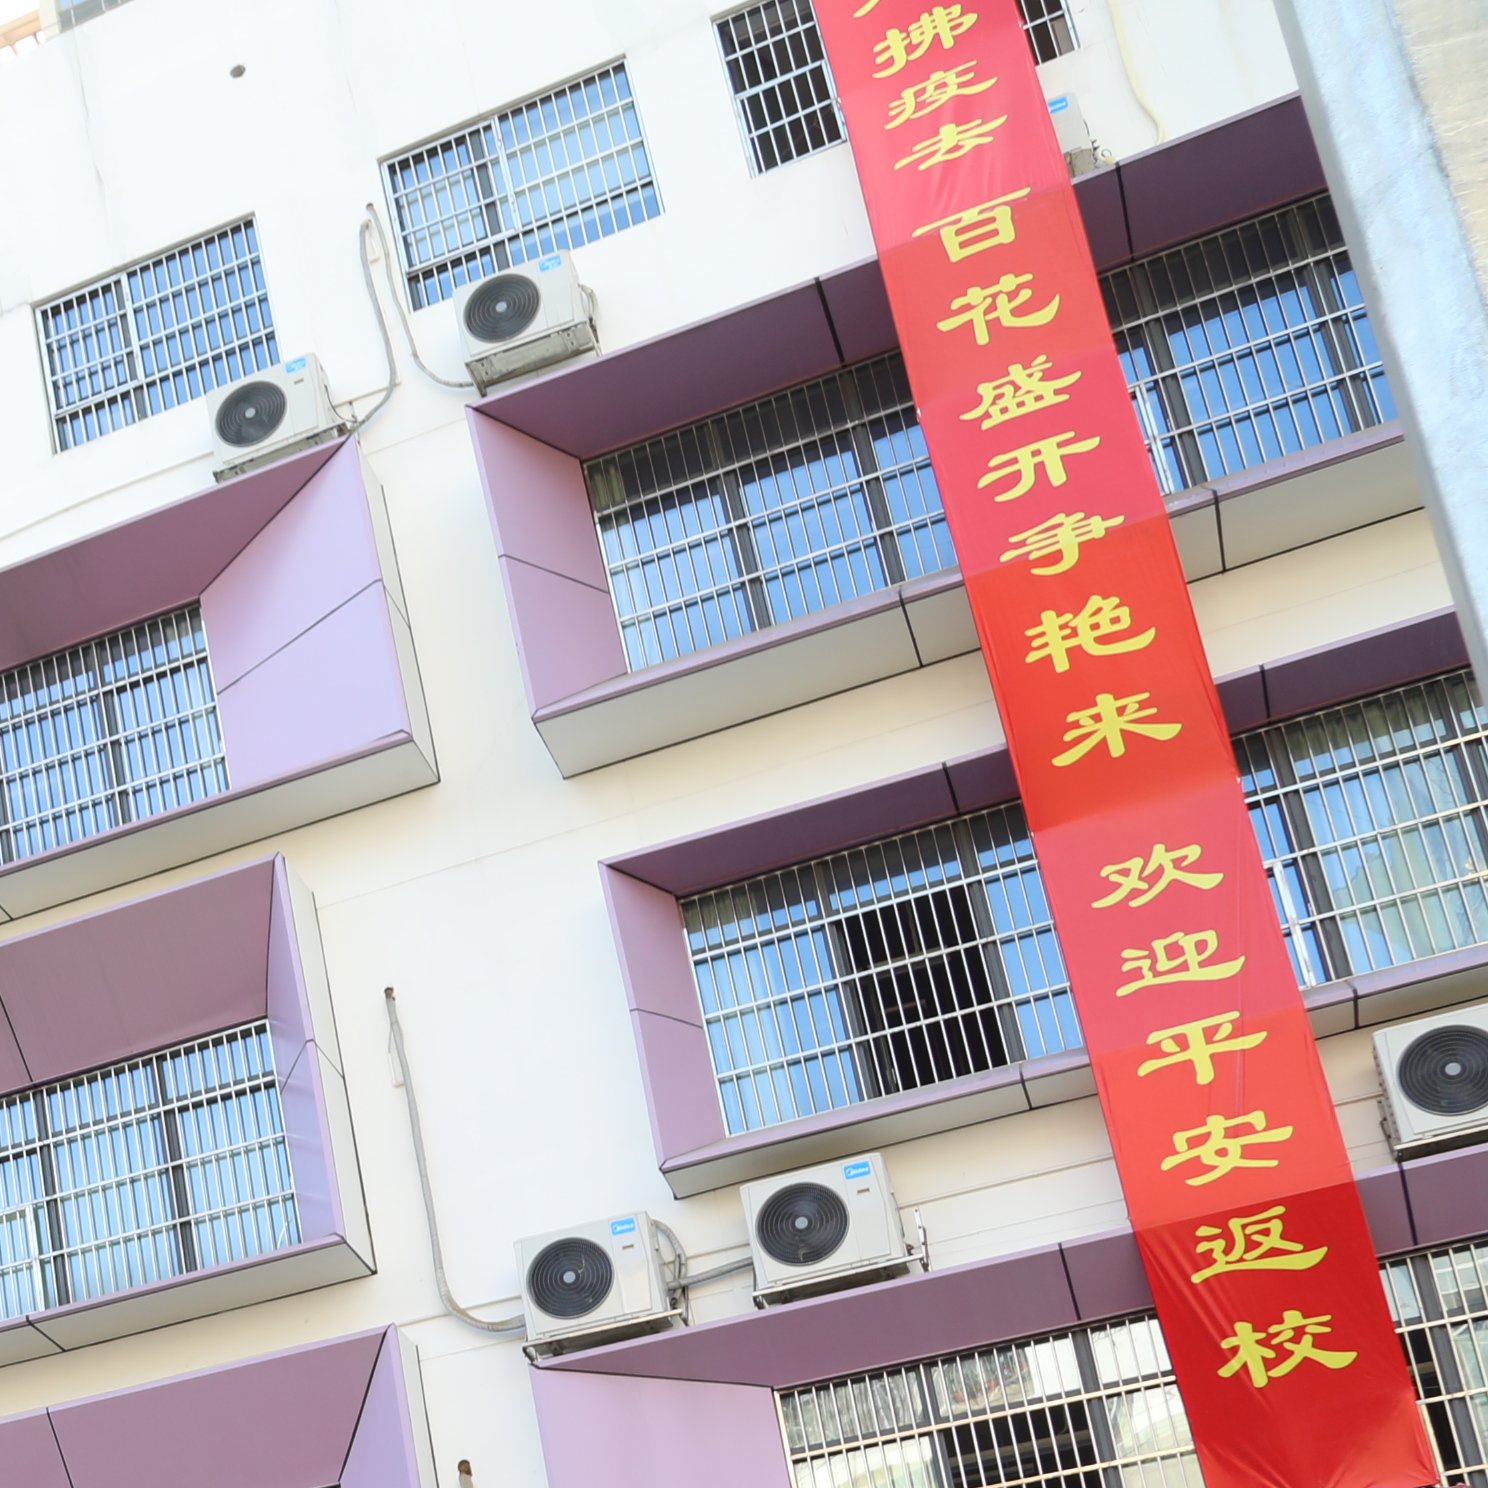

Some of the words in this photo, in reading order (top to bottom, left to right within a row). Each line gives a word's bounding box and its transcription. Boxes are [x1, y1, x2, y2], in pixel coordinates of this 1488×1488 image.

[912, 187, 1183, 768] 百花盛开争艳来
[1091, 843, 1358, 1388] 欢迎平安返校
